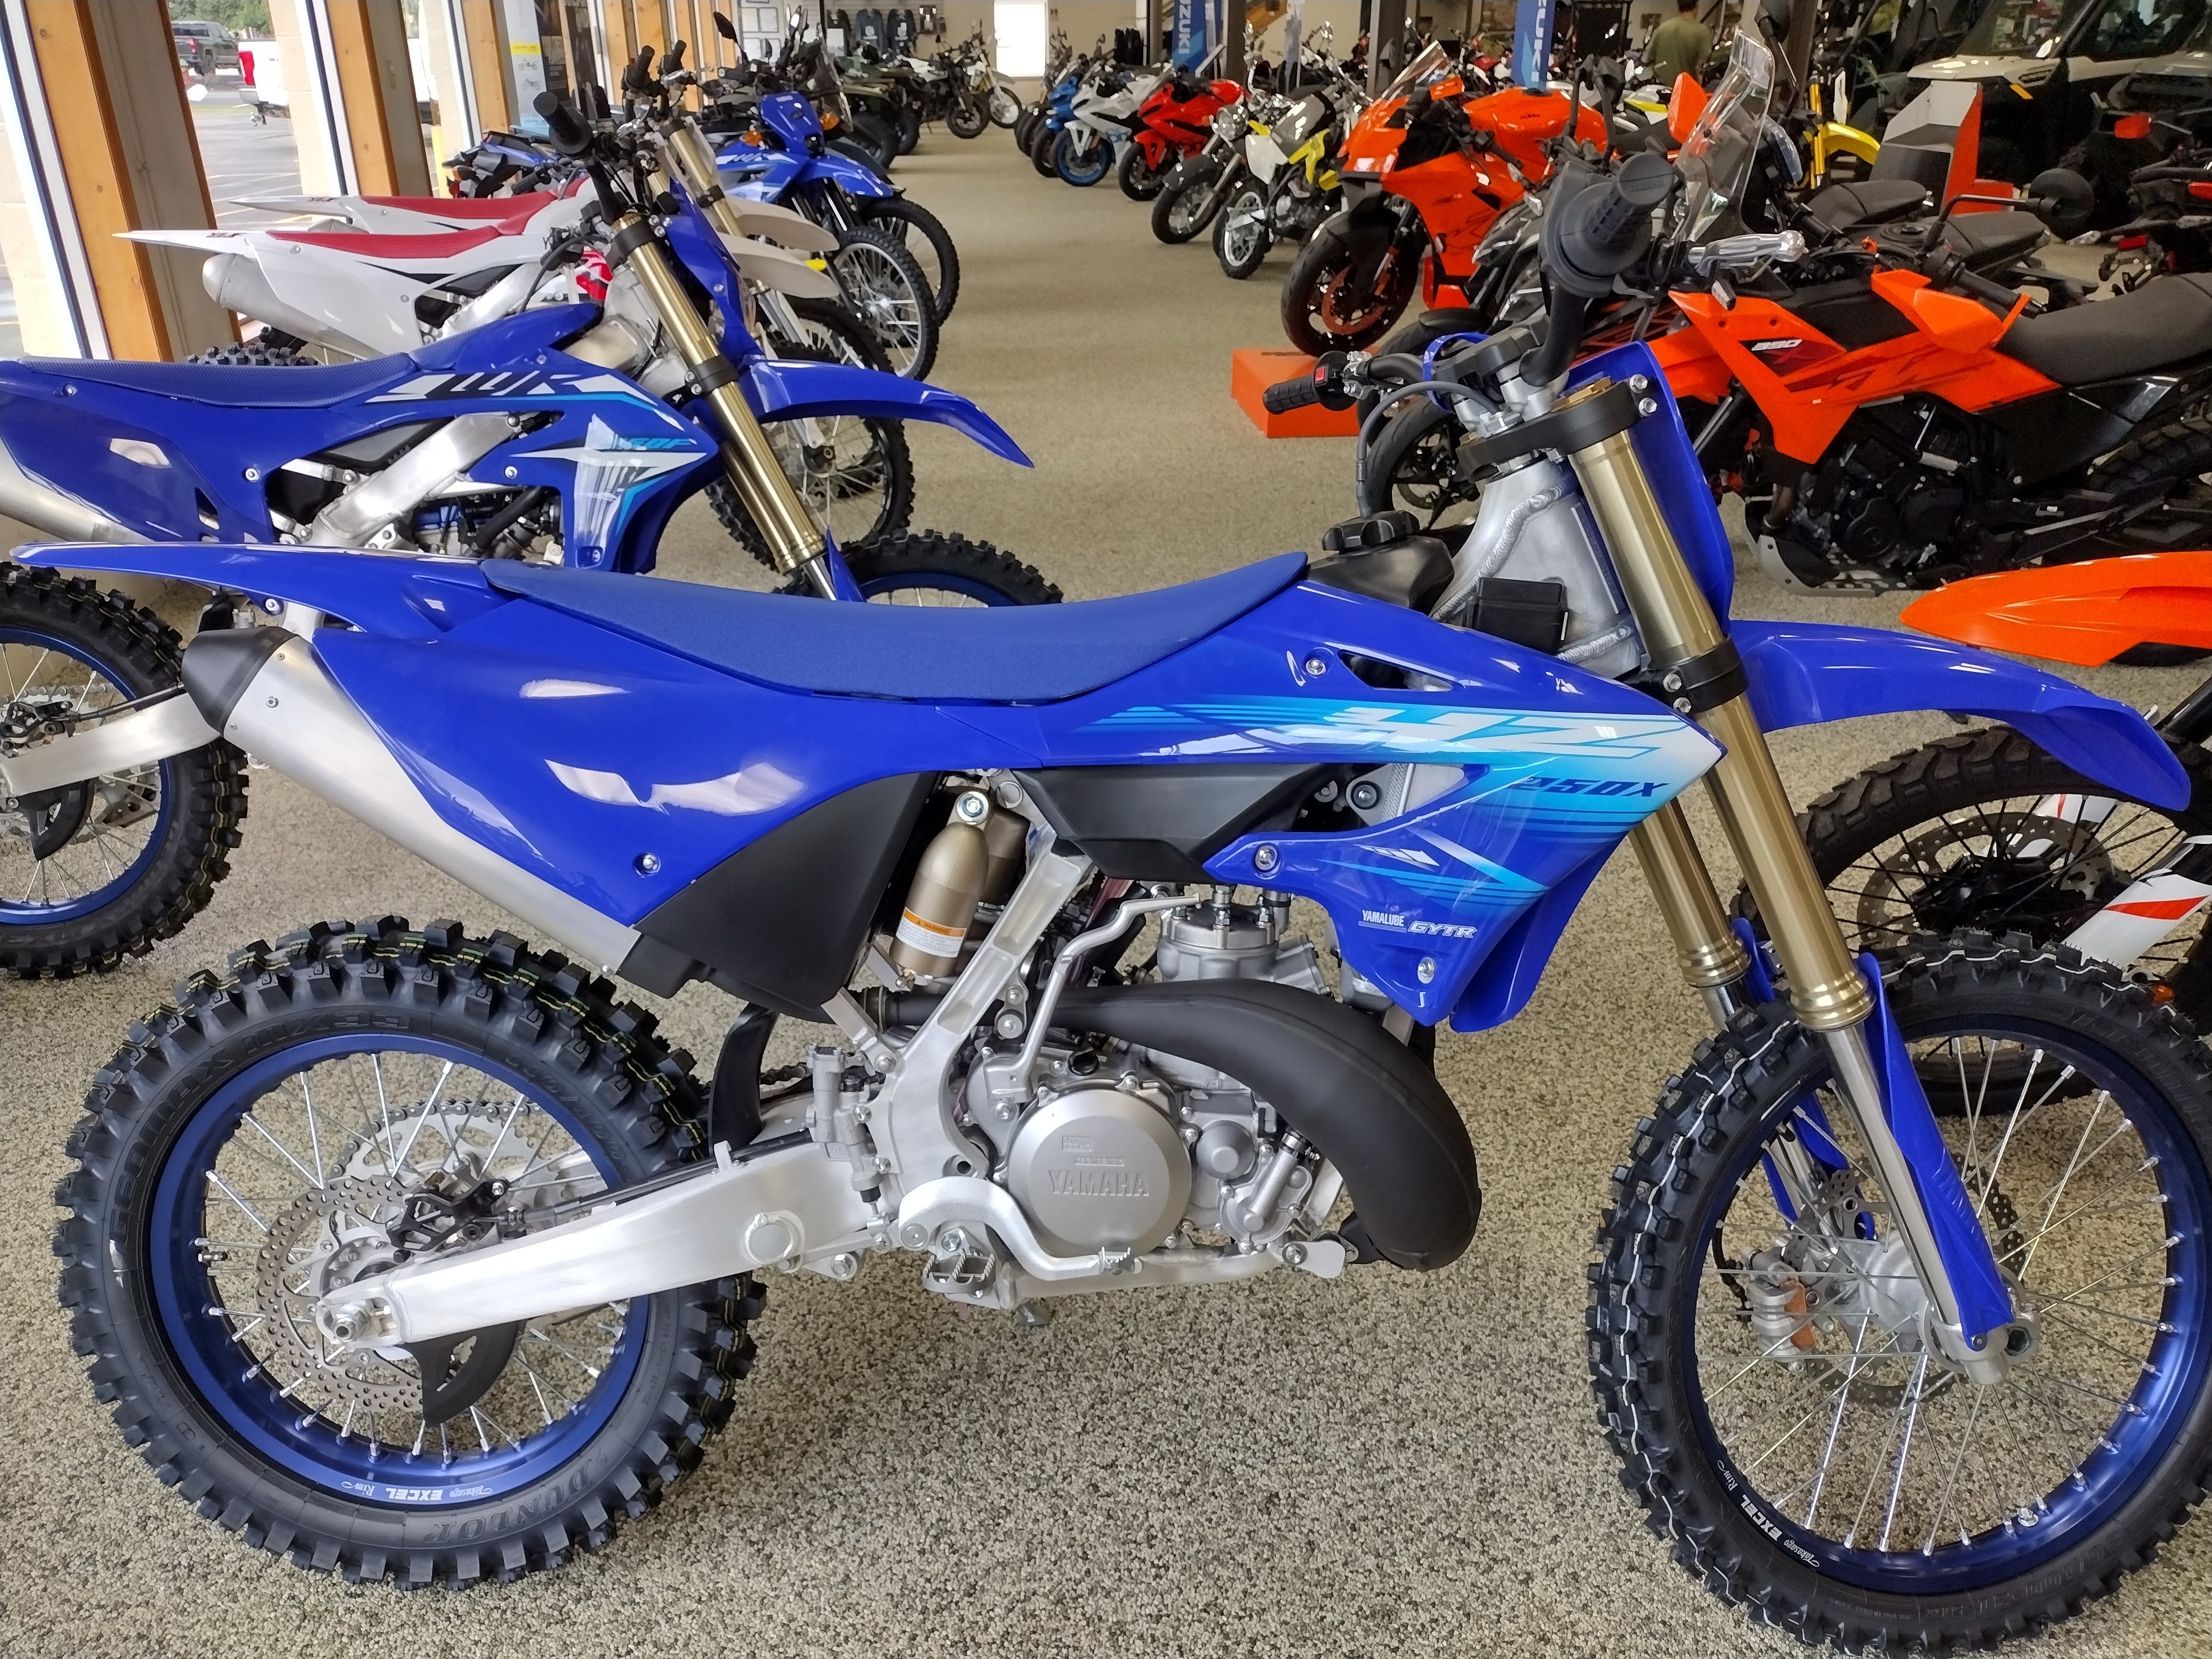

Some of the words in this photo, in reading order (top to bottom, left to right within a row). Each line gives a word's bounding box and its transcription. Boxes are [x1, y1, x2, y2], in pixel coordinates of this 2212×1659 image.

[1504, 776, 1671, 797] 250X
[924, 921, 949, 934] WARNING
[1362, 909, 1405, 927] YAMALUBE
[1407, 920, 1478, 938] GYTR
[1048, 1170, 1149, 1197] YAMAHA
[385, 1487, 444, 1501] EXCEL
[424, 1458, 593, 1544] DUNLOP
[1740, 1494, 1782, 1541] EXCEL
[1783, 1539, 1820, 1568] Takasago
